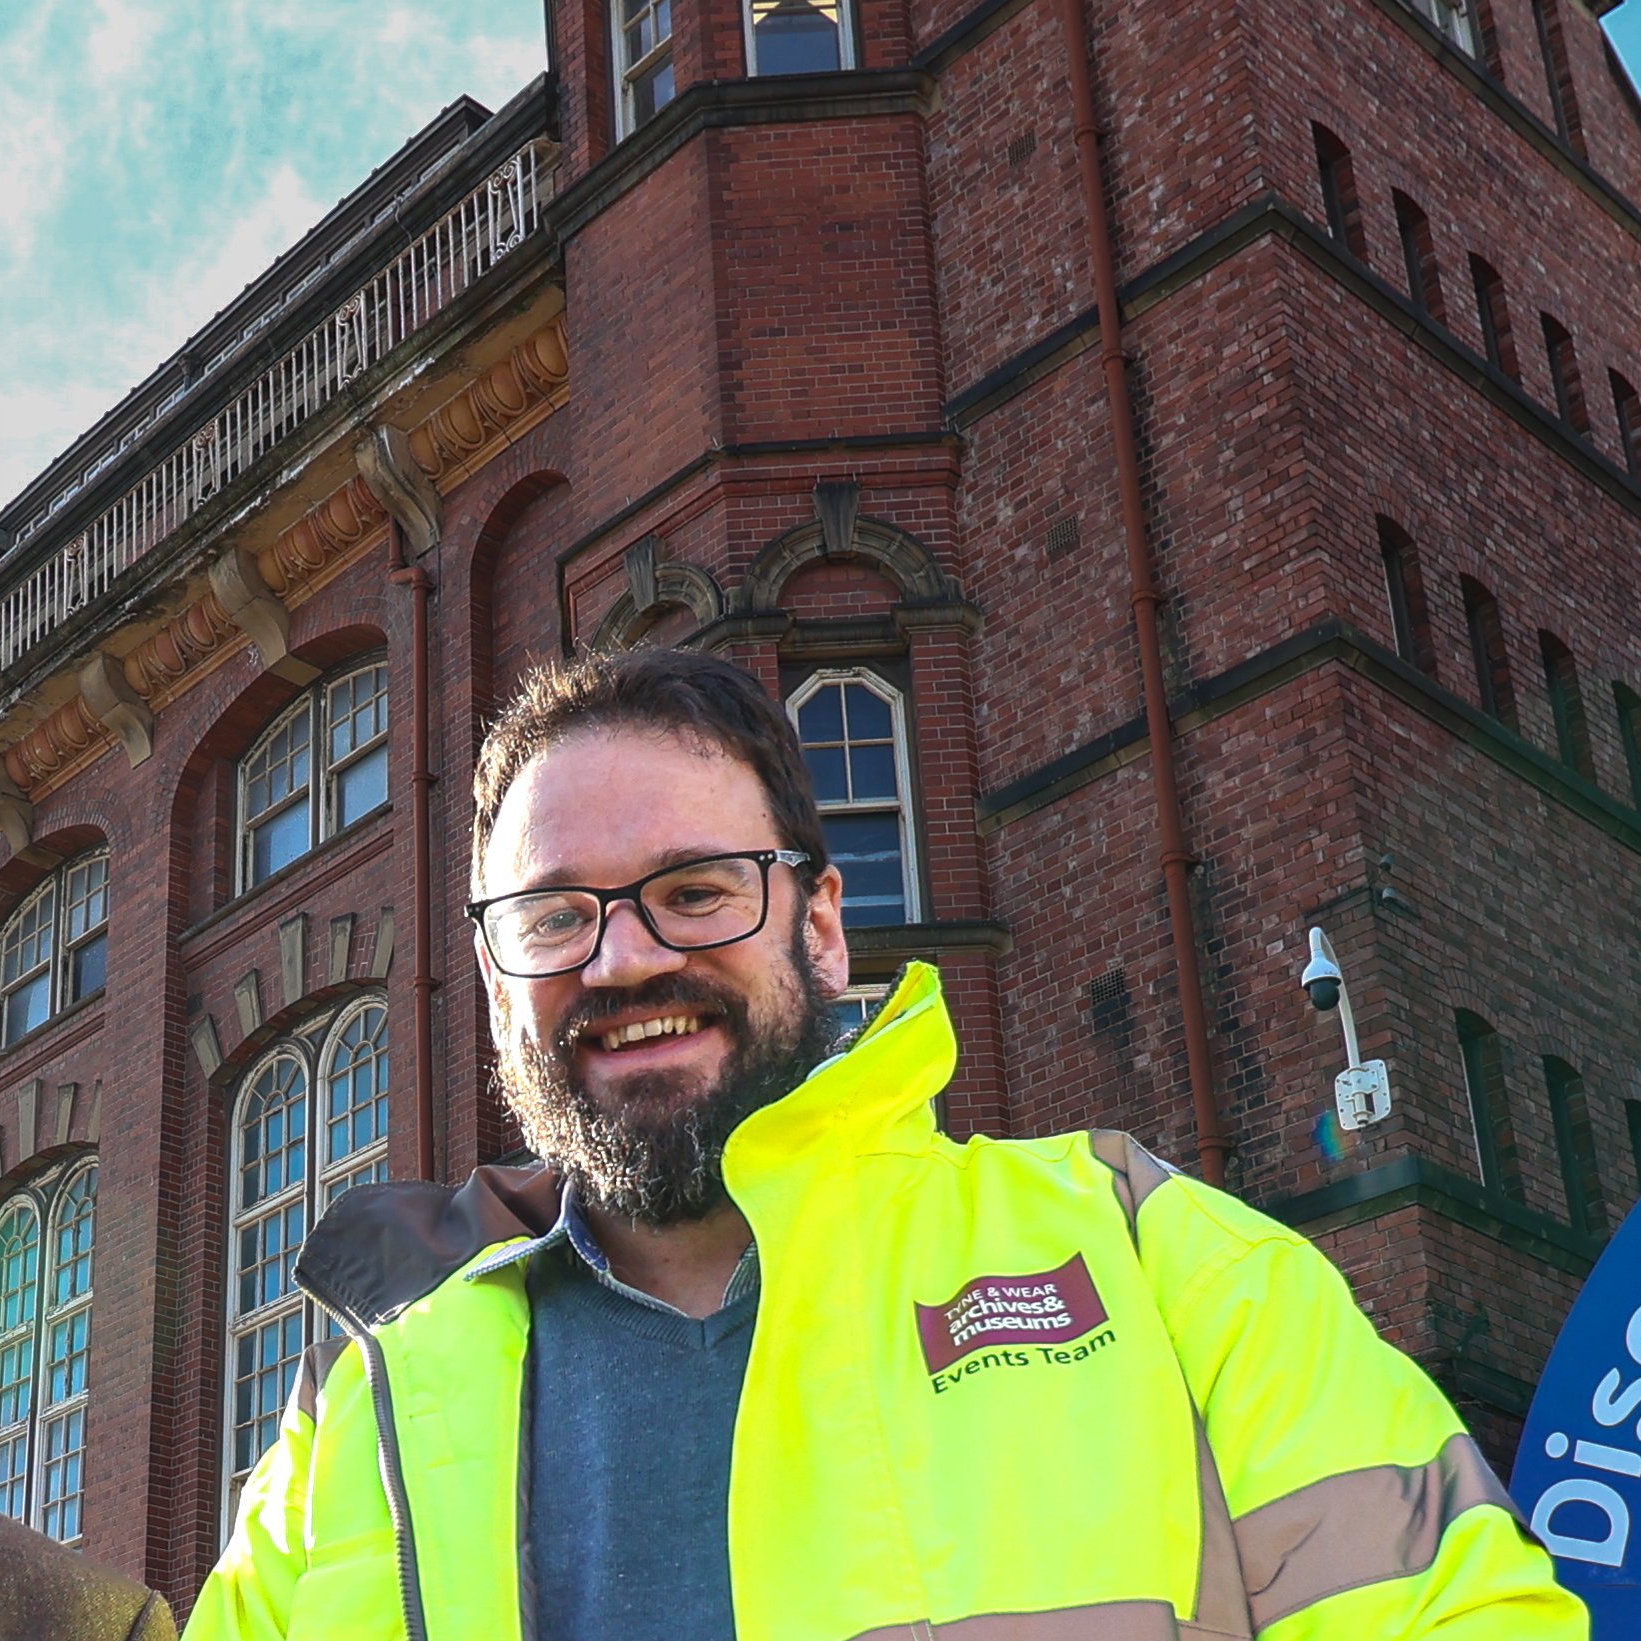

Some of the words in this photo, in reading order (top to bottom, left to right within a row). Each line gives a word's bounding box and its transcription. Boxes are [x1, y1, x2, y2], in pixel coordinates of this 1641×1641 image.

[944, 1289, 983, 1320] TYNE
[987, 1286, 1001, 1297] &
[1002, 1283, 1057, 1298] WEAR
[949, 1296, 1066, 1334] archives&
[953, 1313, 1073, 1346] museums
[931, 1350, 1029, 1394] Events
[1035, 1329, 1117, 1364] Team
